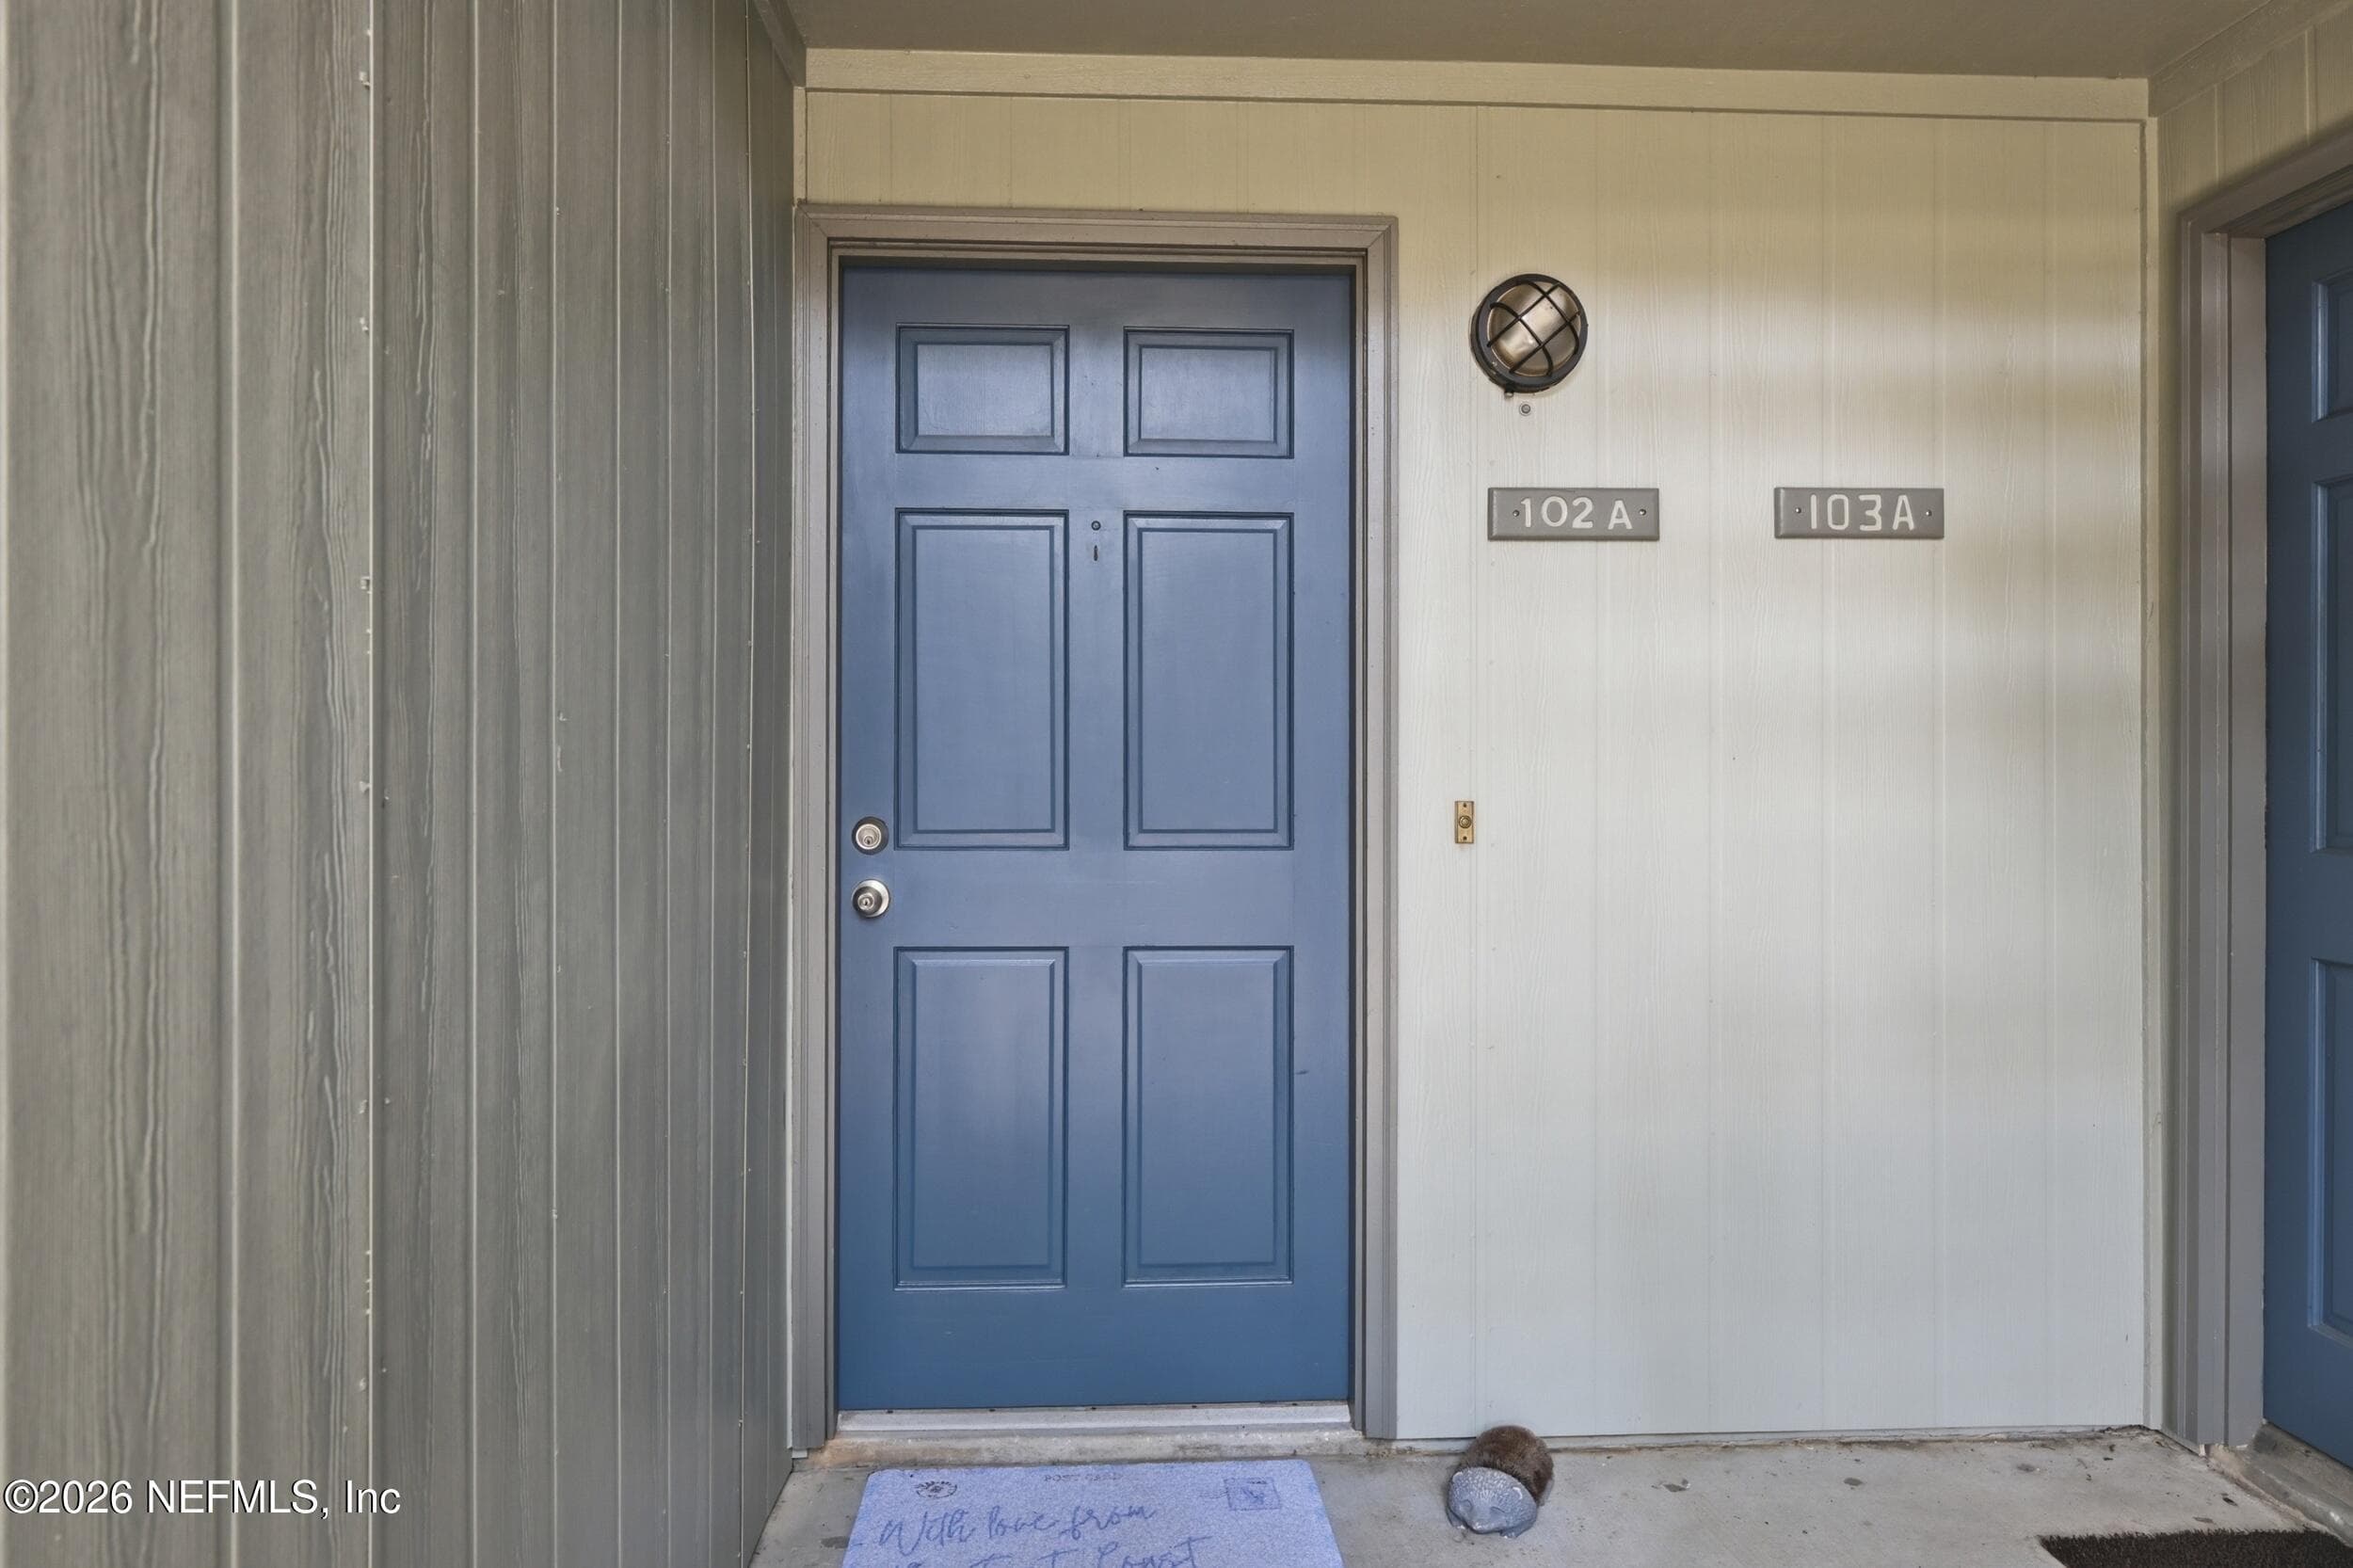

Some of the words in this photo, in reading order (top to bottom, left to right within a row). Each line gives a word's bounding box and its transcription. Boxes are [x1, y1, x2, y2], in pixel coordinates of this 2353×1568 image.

[1520, 495, 1594, 529] 102
[1608, 500, 1633, 530] A
[988, 1505, 1061, 1539] love
[1058, 1504, 1157, 1541] from
